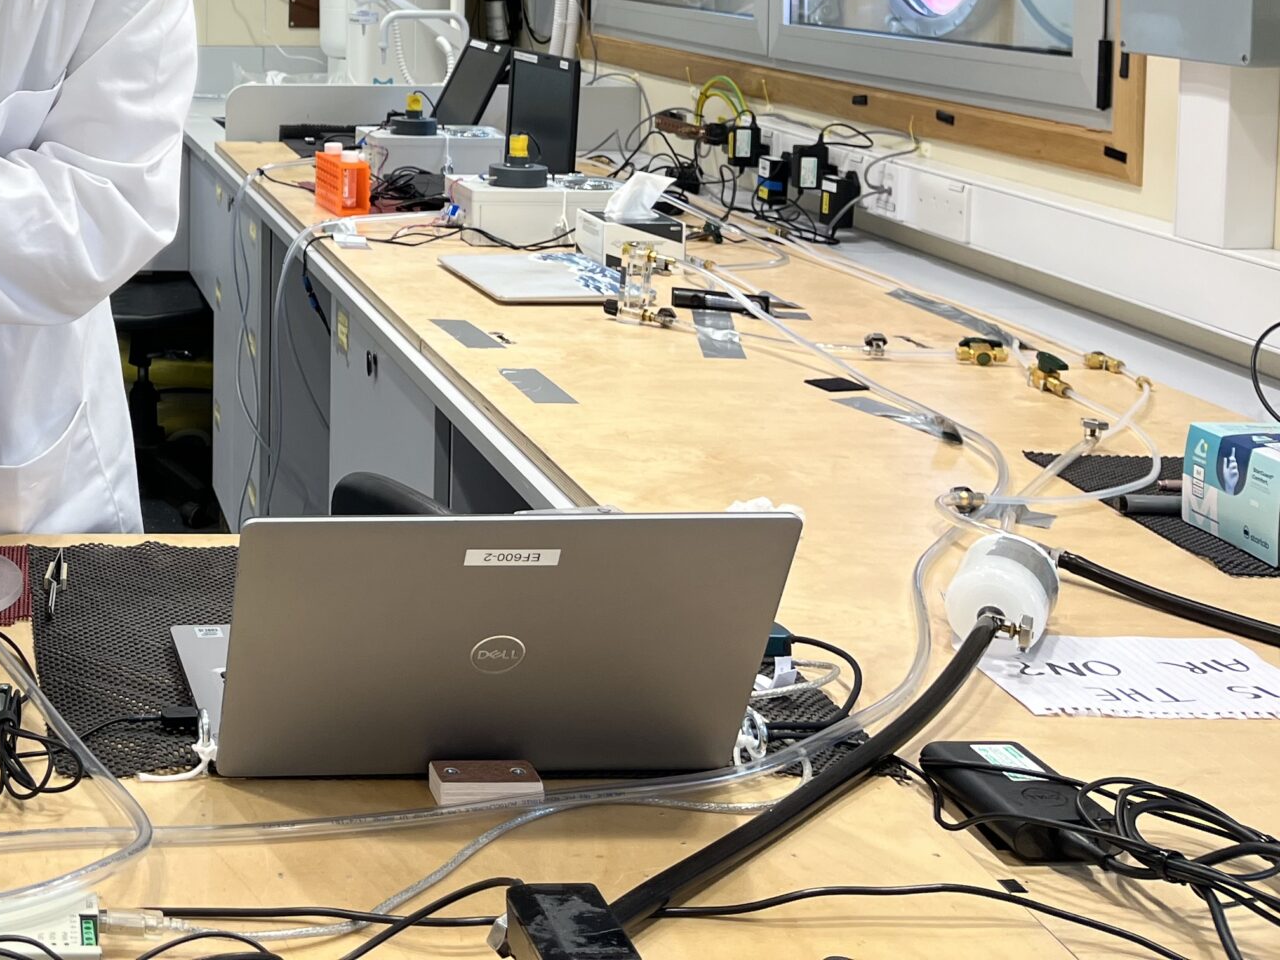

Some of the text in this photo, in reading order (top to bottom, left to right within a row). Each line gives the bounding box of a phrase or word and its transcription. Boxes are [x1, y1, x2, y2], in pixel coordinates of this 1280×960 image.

[483, 552, 541, 562] EF600-2
[477, 650, 519, 660] DELL
[1155, 658, 1250, 675] AIR
[1083, 687, 1197, 703] THE
